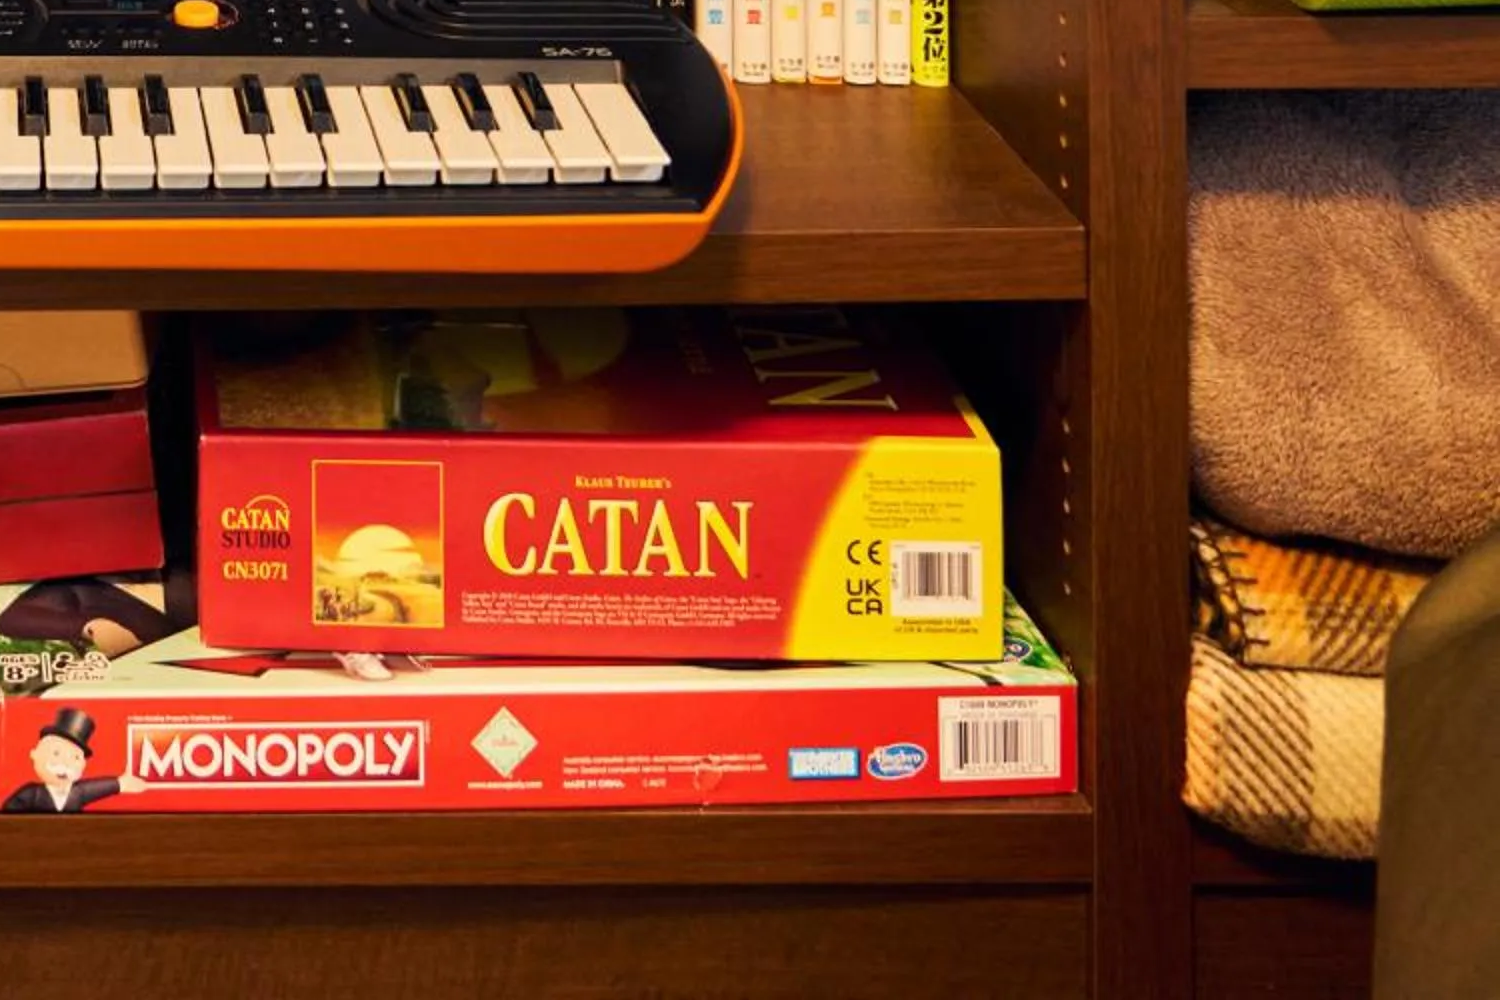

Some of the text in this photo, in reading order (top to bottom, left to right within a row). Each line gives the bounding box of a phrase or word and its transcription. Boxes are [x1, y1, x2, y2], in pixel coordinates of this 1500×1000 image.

[221, 505, 290, 530] CATAN
[222, 531, 290, 549] STUDIO
[483, 492, 754, 580] CATAN
[223, 560, 289, 580] CN3071
[846, 579, 881, 597] UK
[846, 598, 884, 616] CA
[139, 731, 416, 777] MONOPOLY
